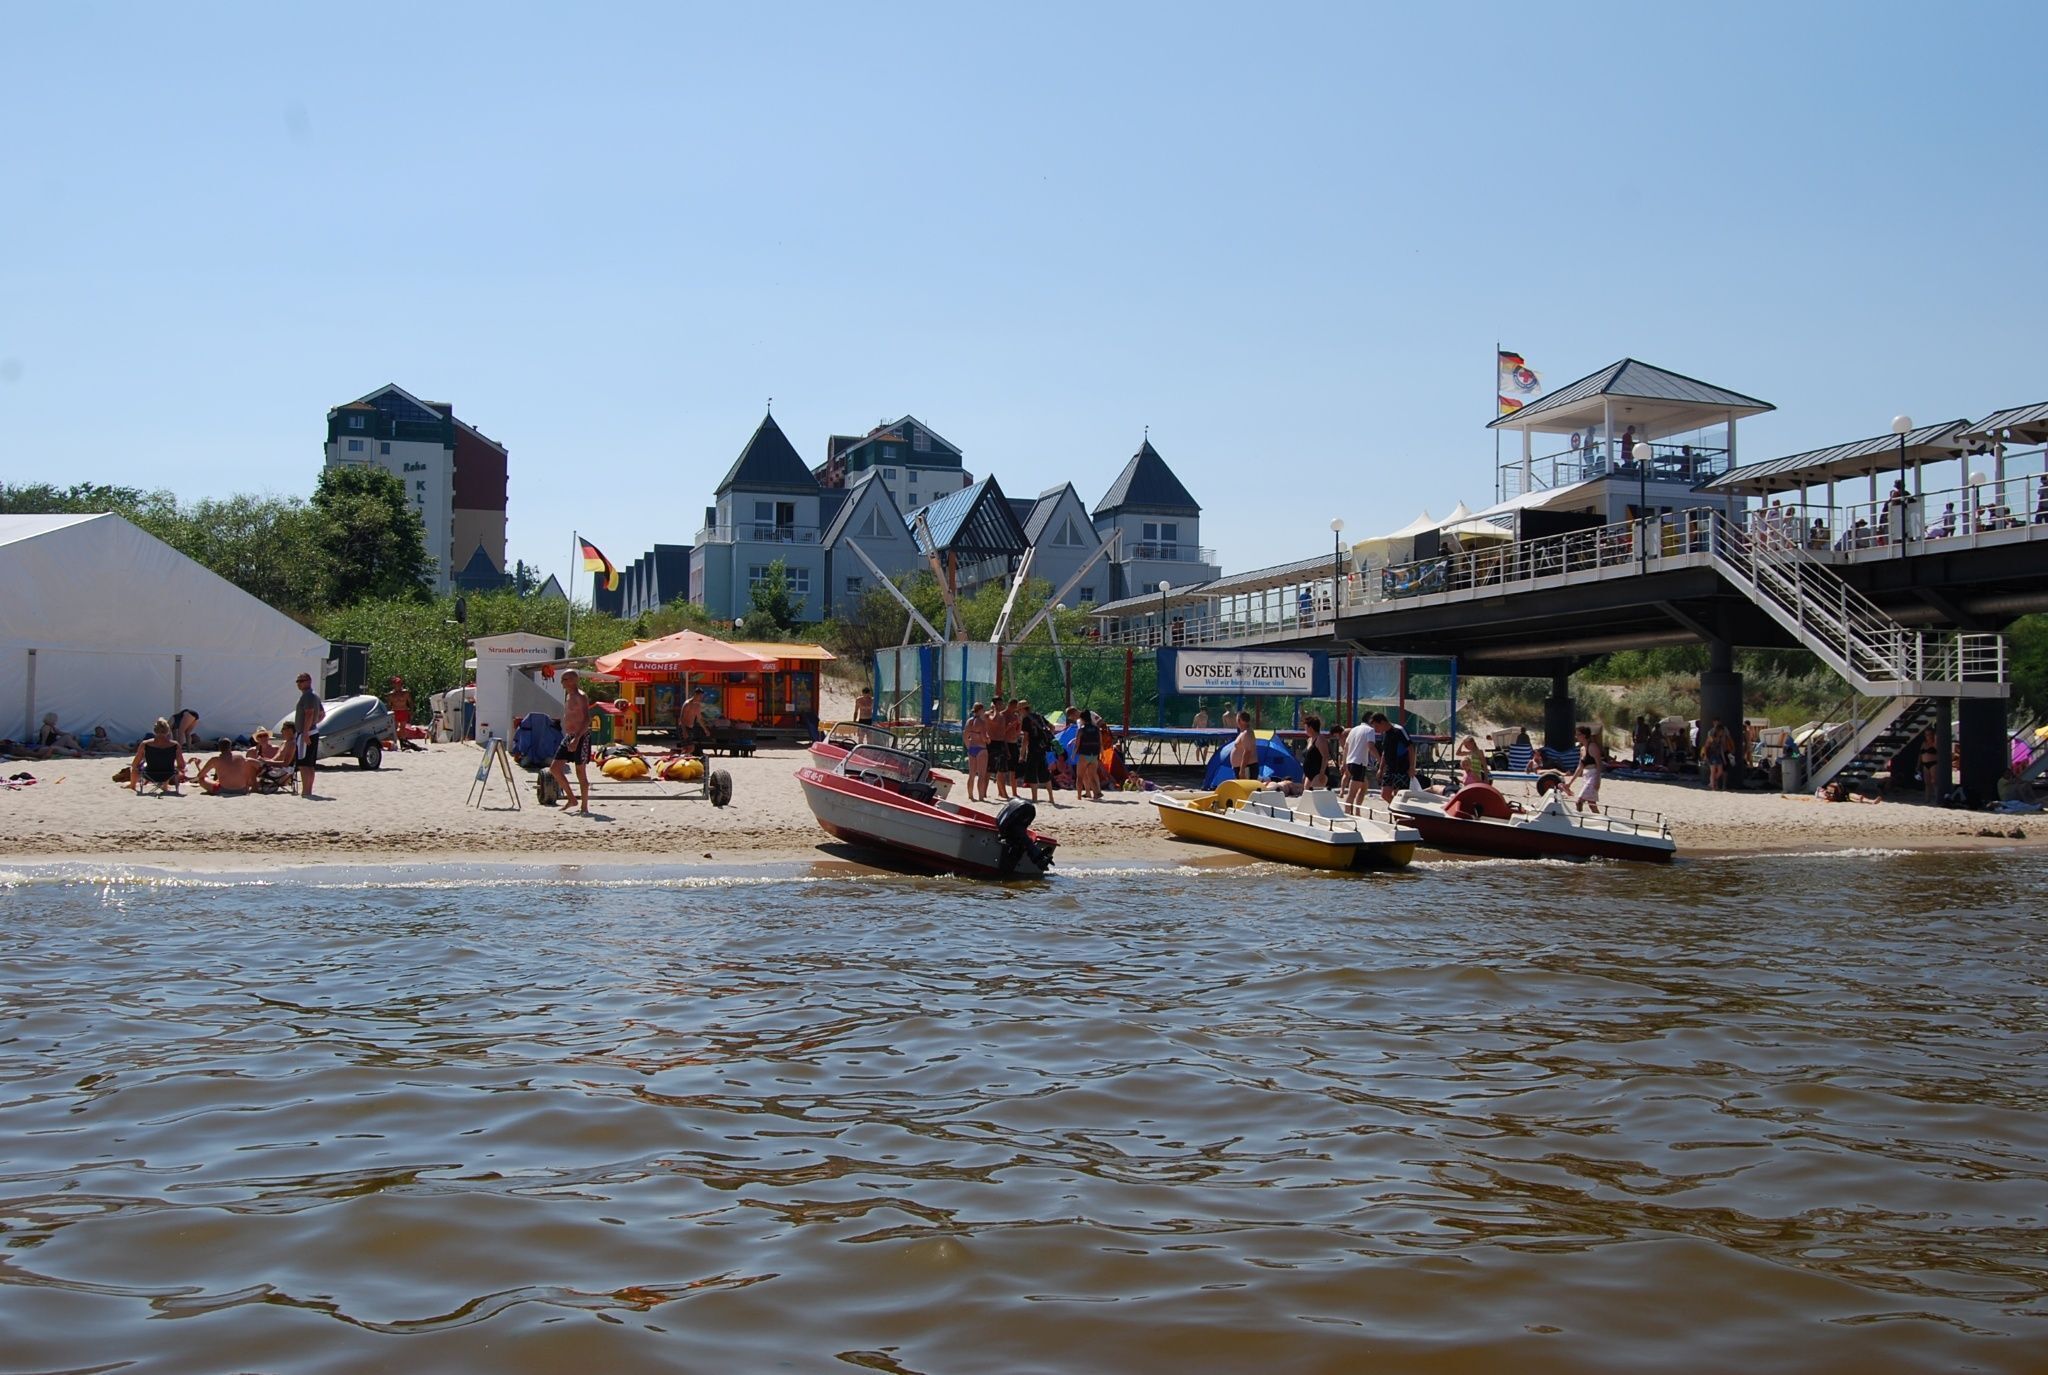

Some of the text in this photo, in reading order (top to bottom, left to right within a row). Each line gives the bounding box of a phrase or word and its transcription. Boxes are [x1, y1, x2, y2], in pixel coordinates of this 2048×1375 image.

[403, 461, 426, 472] Reha
[633, 662, 679, 671] LANGNESE
[1185, 664, 1306, 679] OSTSEE ZEITUNG
